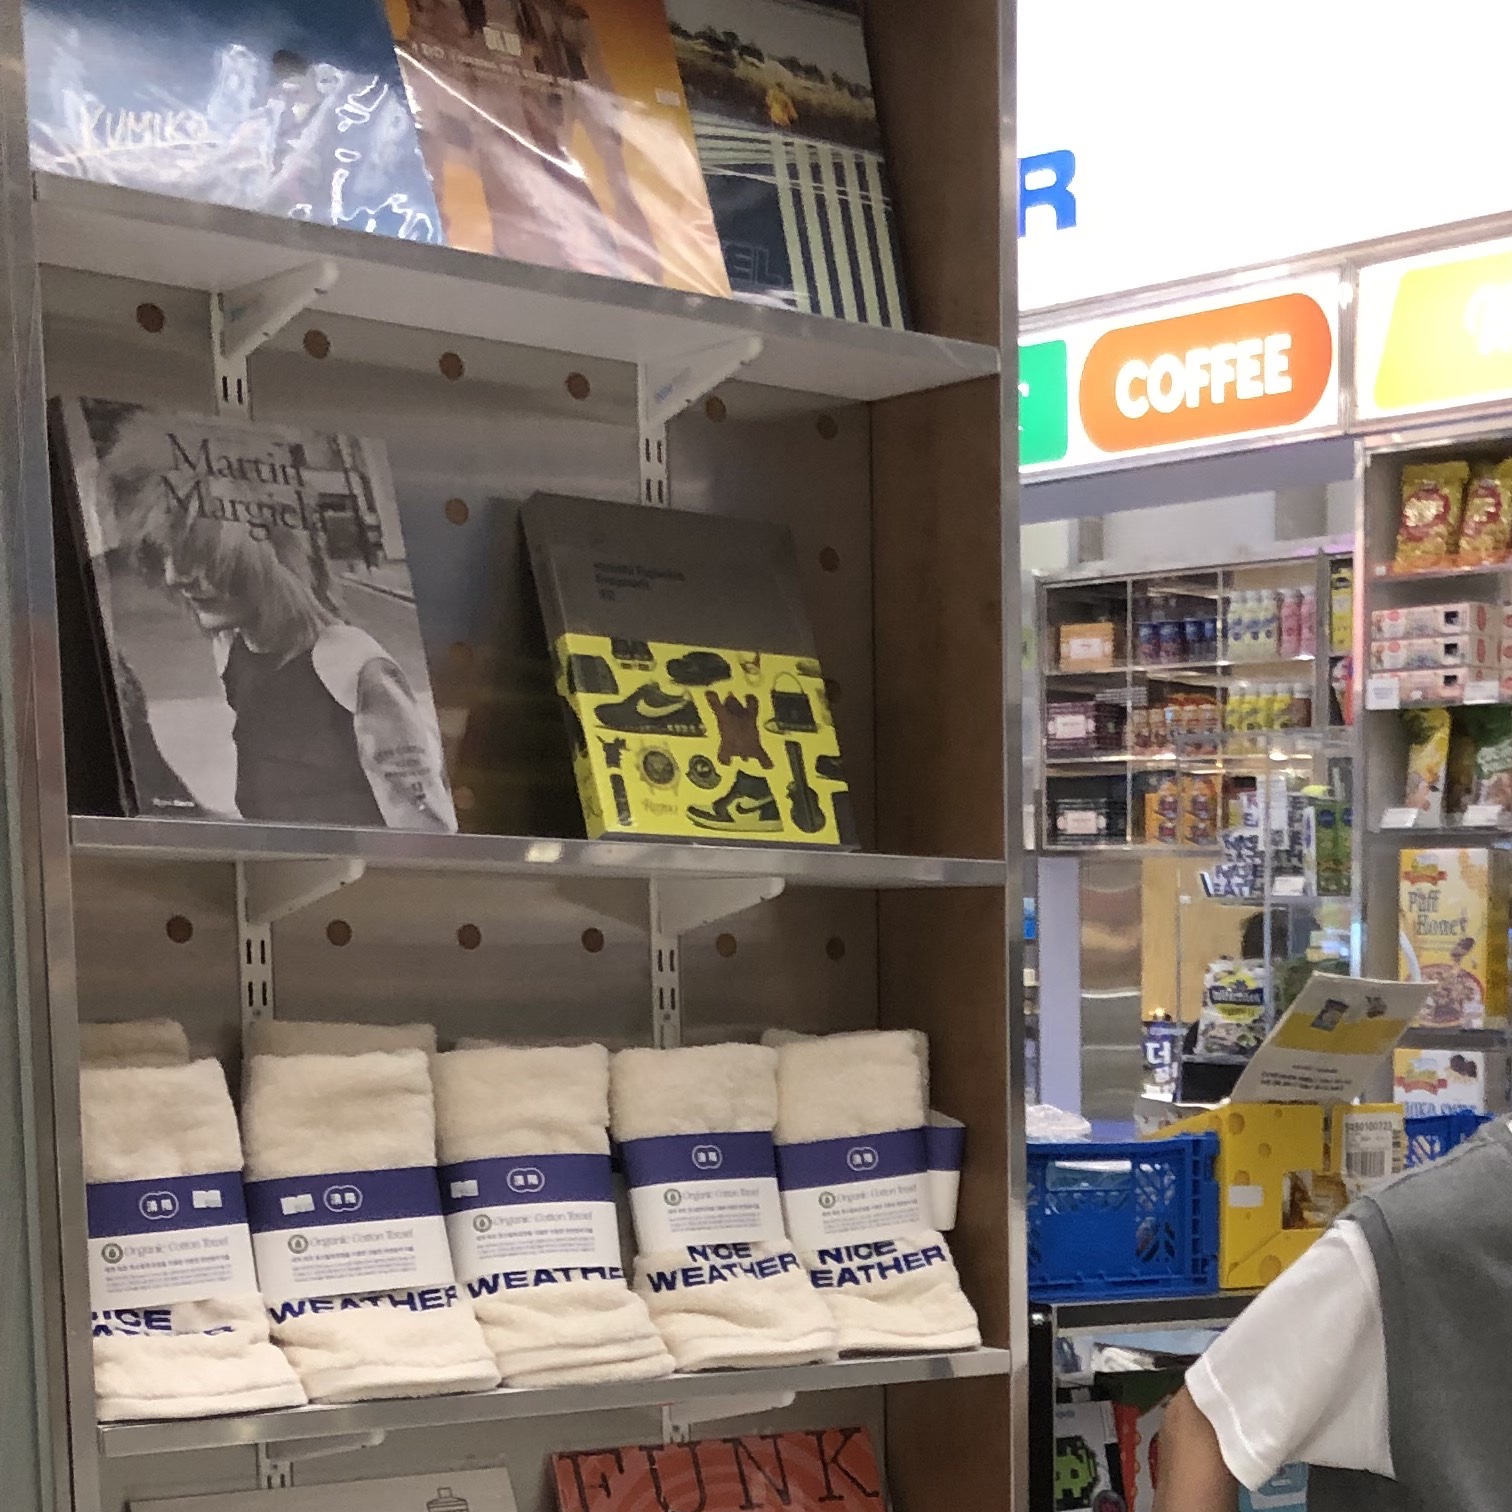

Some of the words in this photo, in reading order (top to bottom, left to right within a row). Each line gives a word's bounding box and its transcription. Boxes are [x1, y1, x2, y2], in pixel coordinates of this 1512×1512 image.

[1115, 332, 1294, 420] COFFEE
[167, 432, 304, 488] Martin
[646, 1253, 800, 1293] WEATHER
[686, 1242, 752, 1263] NCE
[810, 1245, 947, 1289] EATHER
[817, 1240, 897, 1265] NICE
